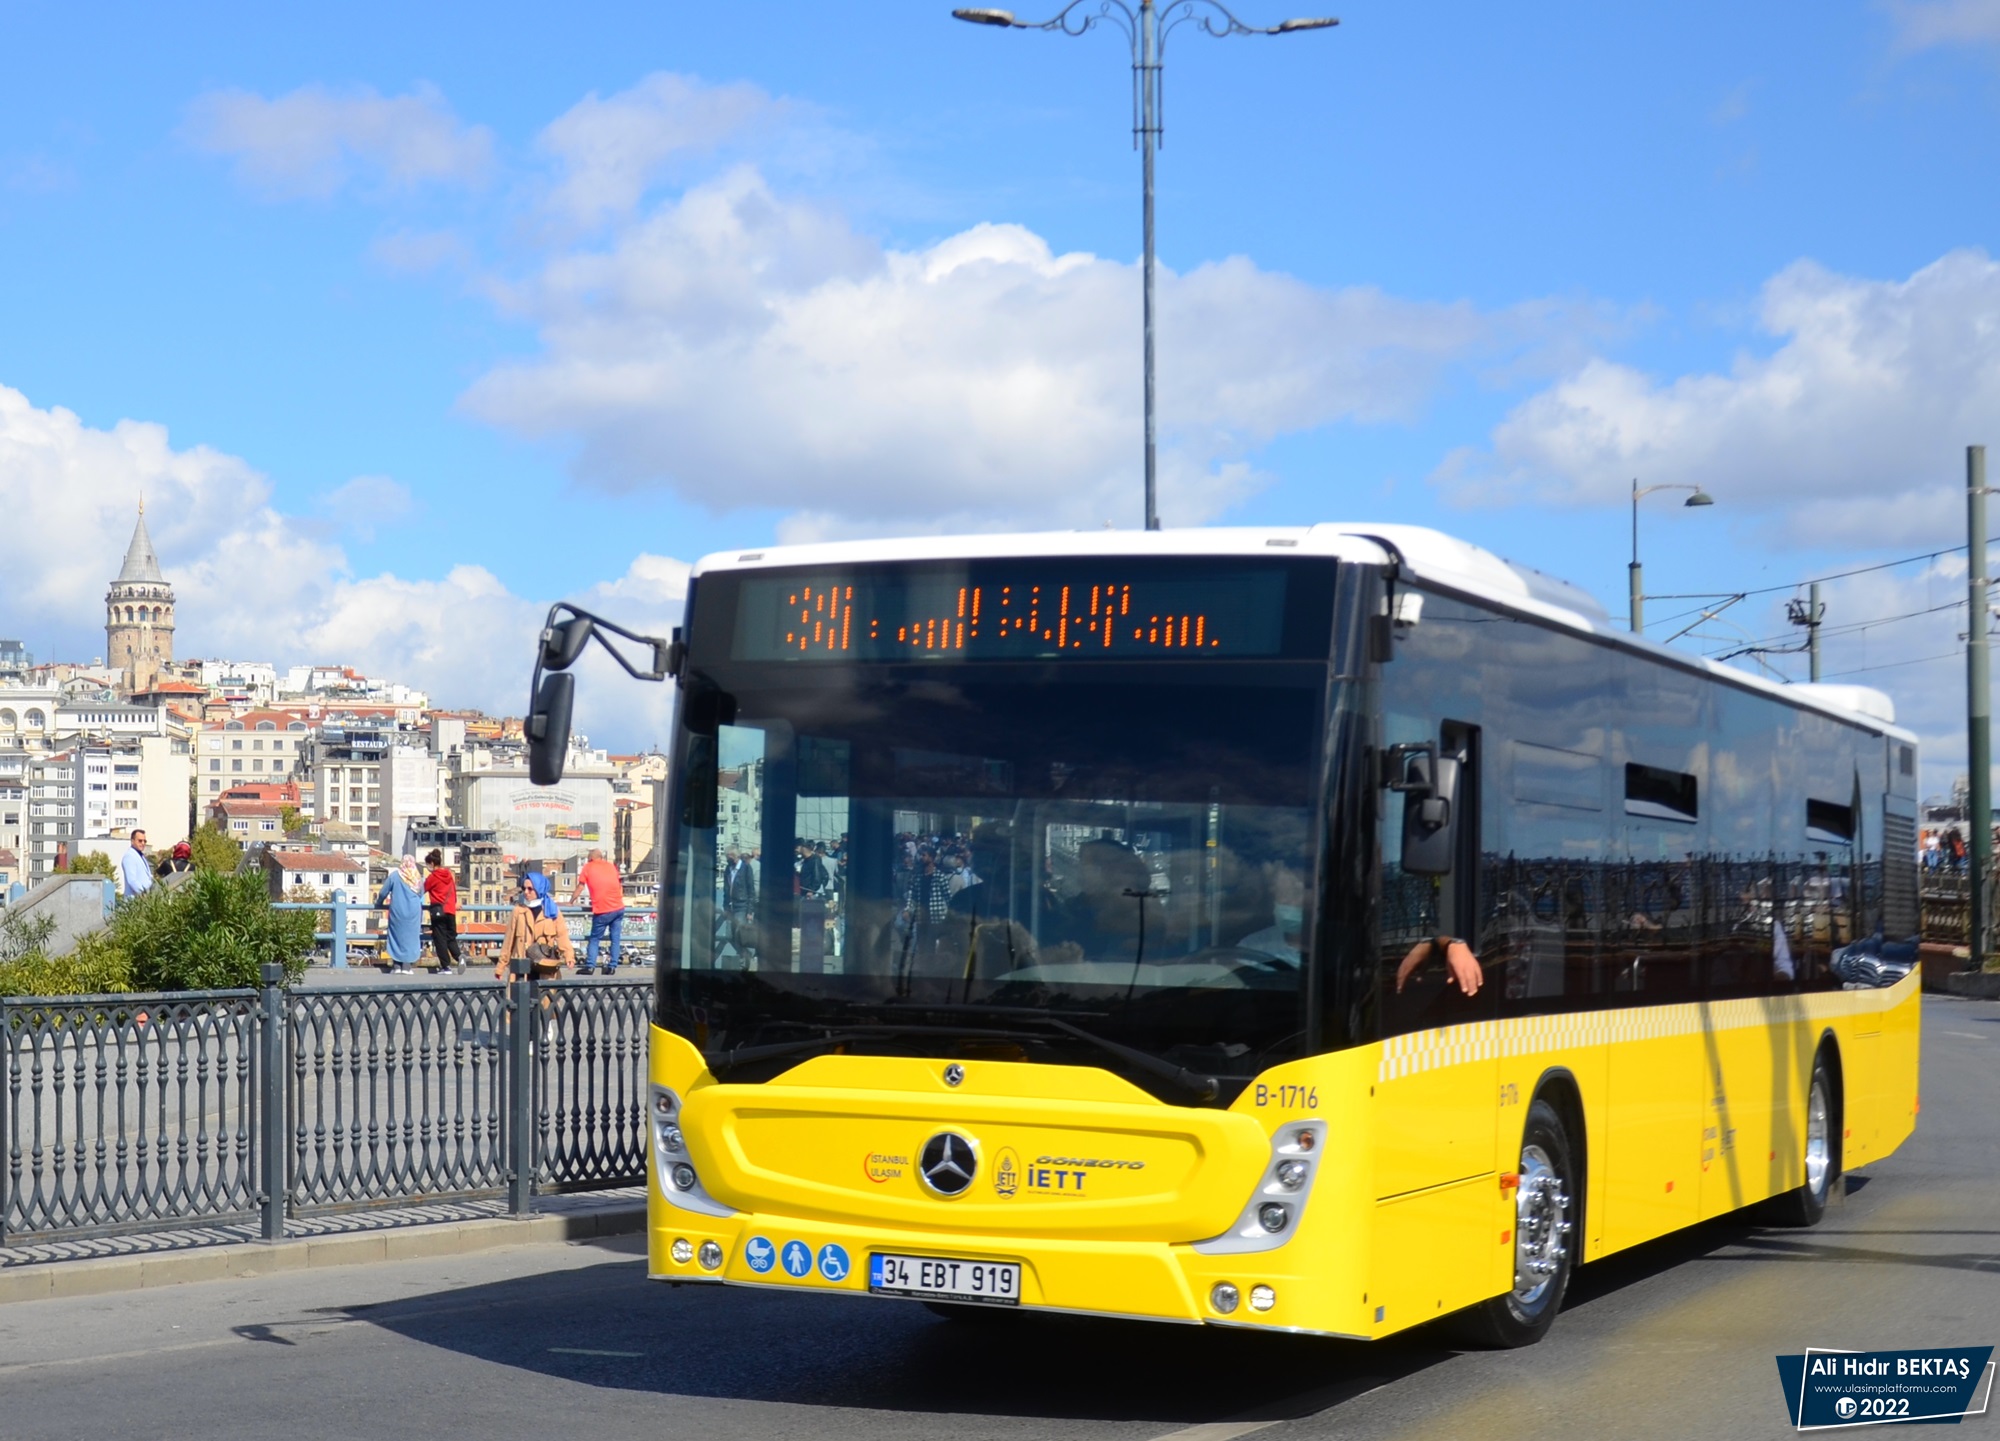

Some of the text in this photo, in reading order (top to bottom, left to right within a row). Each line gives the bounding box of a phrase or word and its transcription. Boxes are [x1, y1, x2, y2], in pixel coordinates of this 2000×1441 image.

[1255, 1084, 1318, 1109] B-1716
[870, 1154, 909, 1165] İSTANBUL
[870, 1168, 902, 1179] ULAŞIM
[1027, 1164, 1087, 1190] İETT
[871, 1272, 883, 1281] TR
[884, 1258, 1013, 1294] 34 EBT 919
